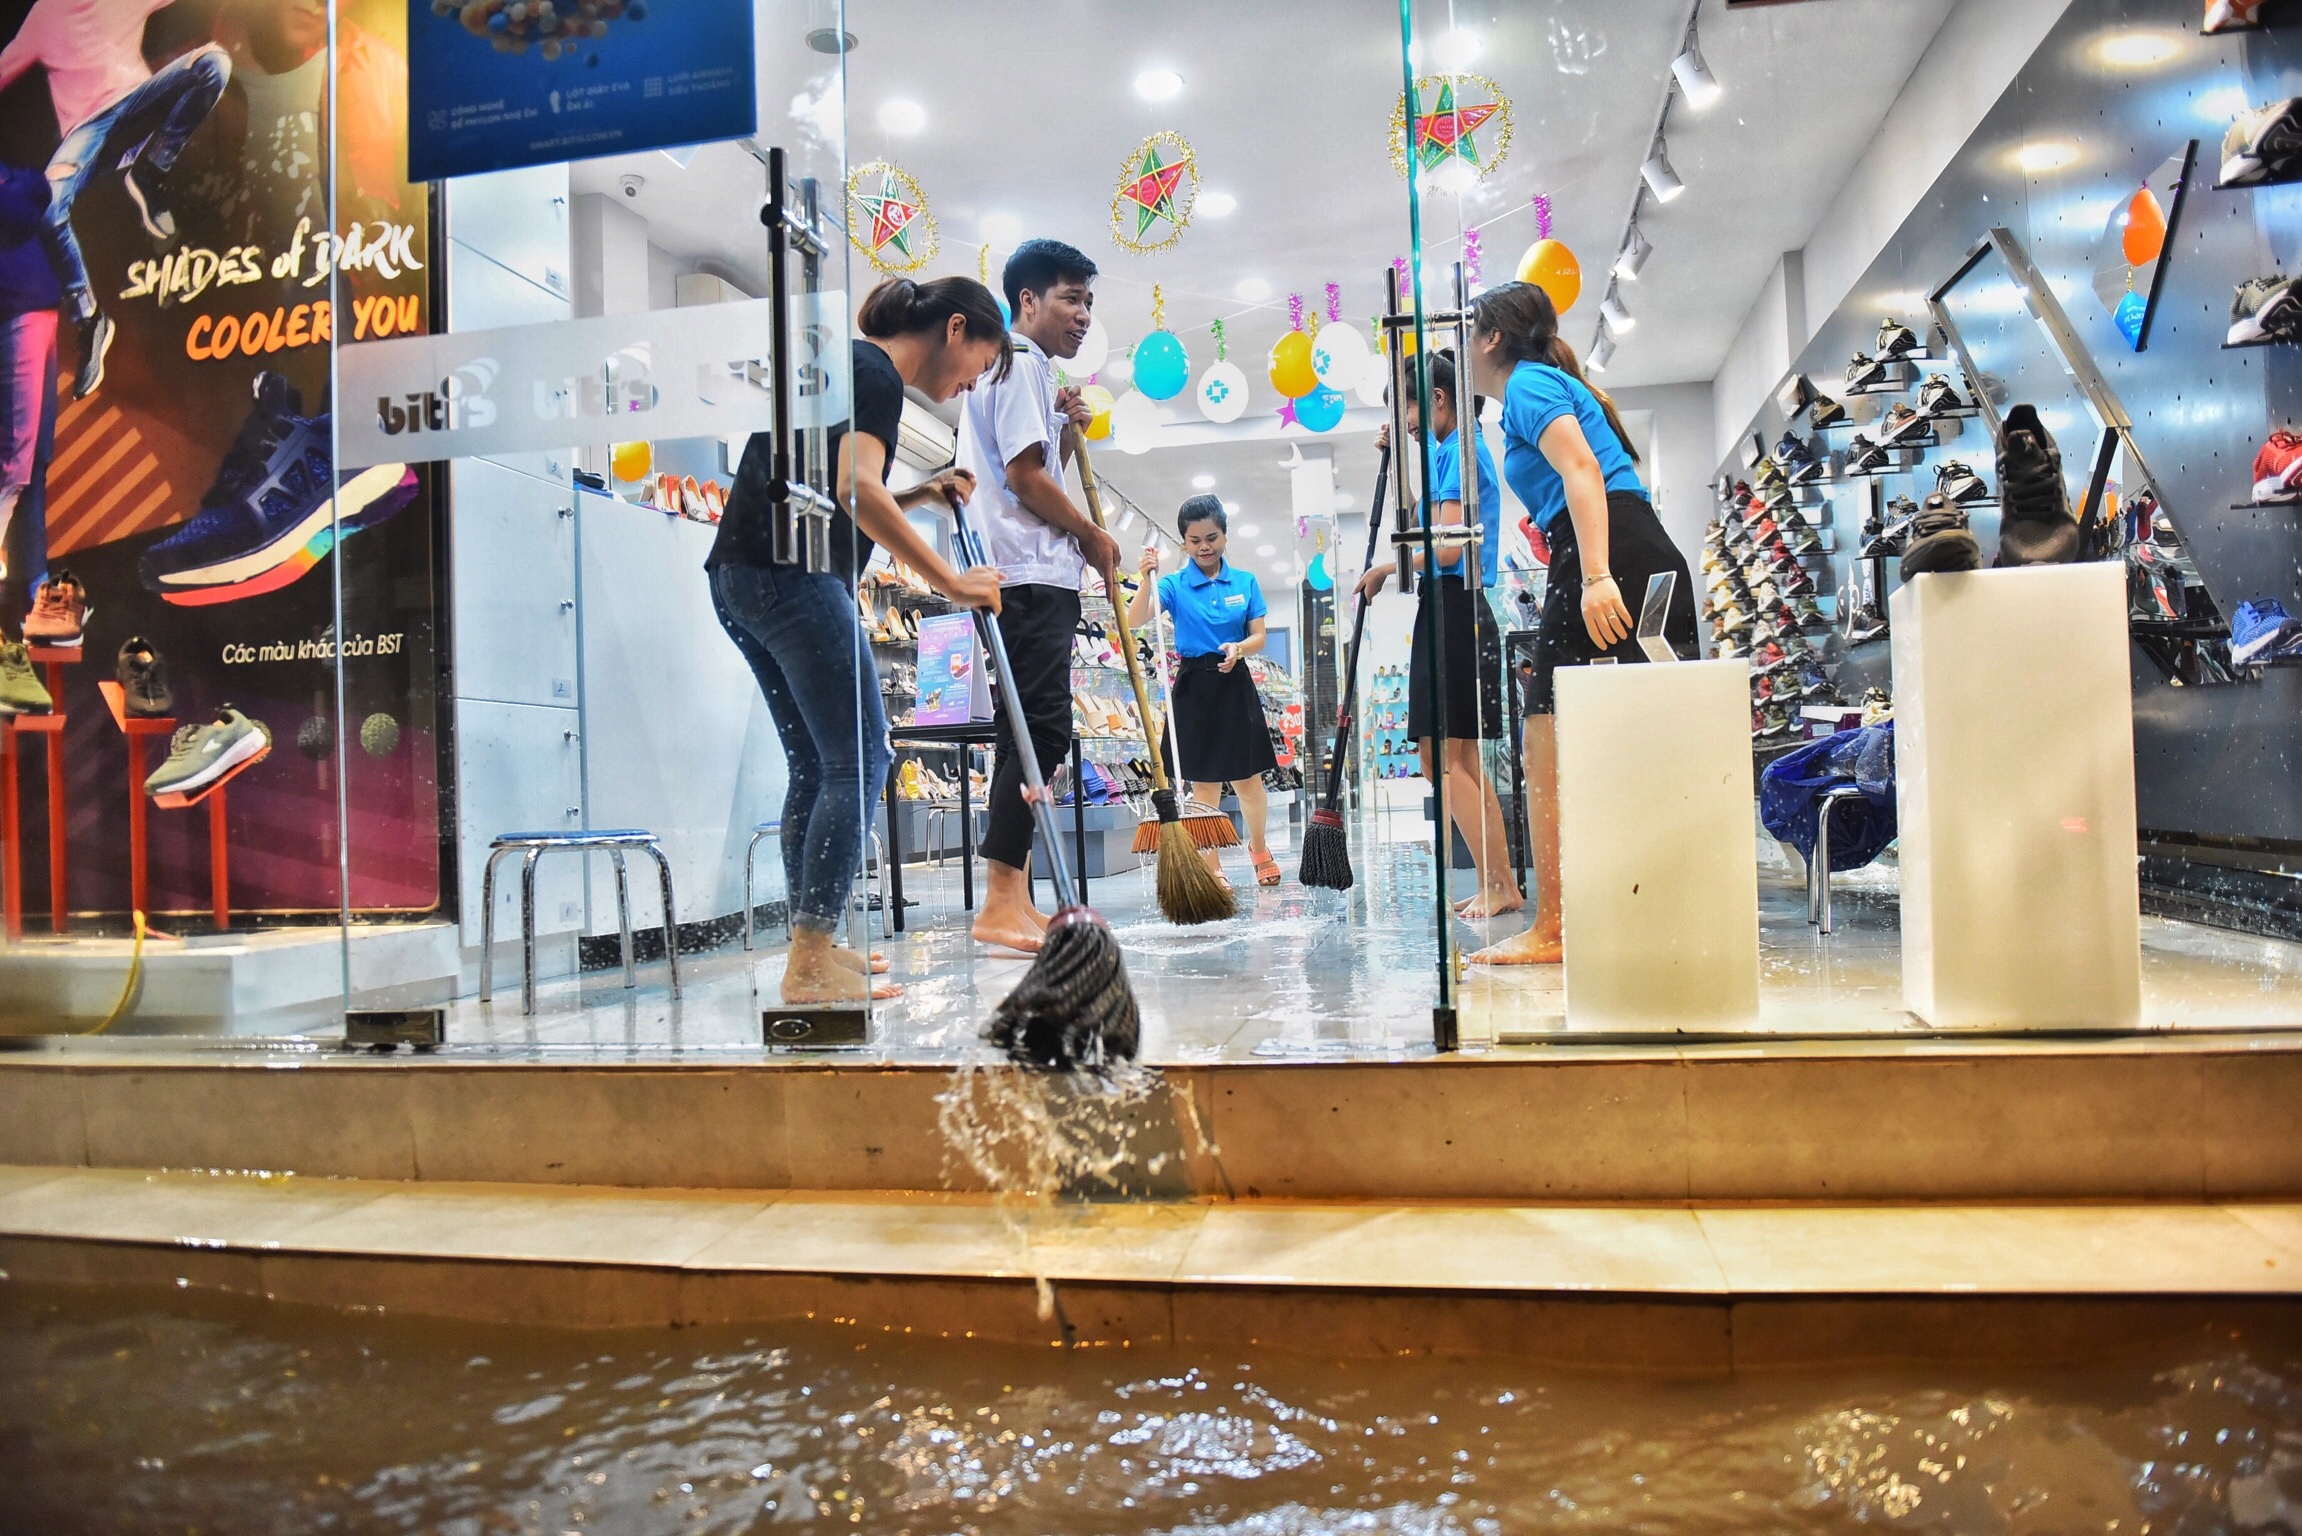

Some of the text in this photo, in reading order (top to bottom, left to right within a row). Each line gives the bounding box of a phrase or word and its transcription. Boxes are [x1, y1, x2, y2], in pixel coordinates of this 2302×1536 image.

[120, 216, 424, 307] SHADES of DARK
[185, 295, 420, 362] COOLER YOU
[222, 634, 403, 665] Các màu khác của BST
